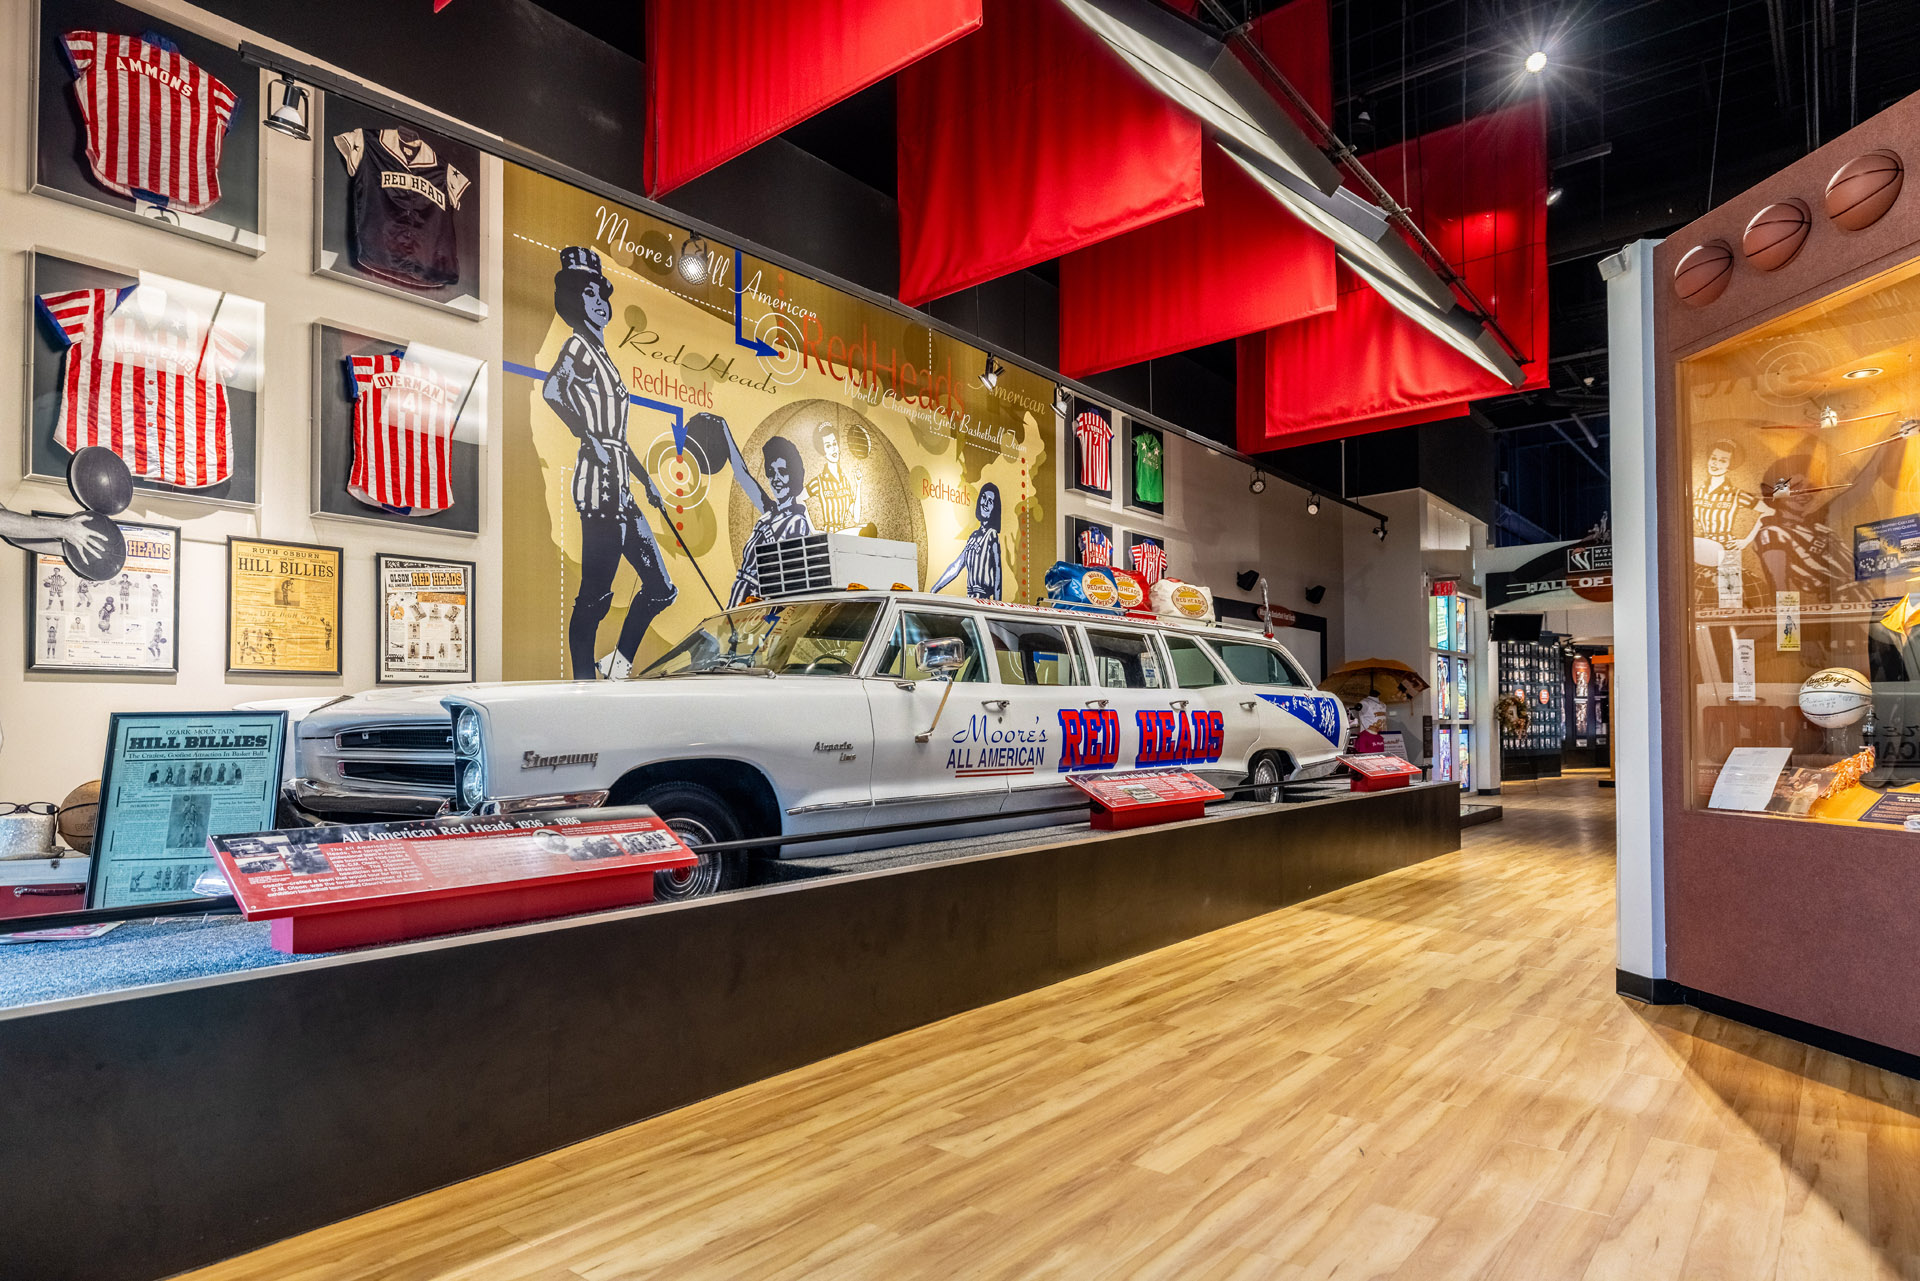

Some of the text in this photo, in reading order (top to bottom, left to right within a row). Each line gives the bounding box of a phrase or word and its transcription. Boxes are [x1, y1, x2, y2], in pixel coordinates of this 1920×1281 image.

[115, 56, 193, 98] AMMONS
[382, 172, 445, 206] RED HEAD
[596, 205, 673, 268] Moore's
[728, 270, 818, 323] American
[802, 313, 967, 420] RedHeads
[377, 375, 440, 399] OVERMAN
[632, 366, 714, 410] RedHeads
[401, 393, 416, 413] 4
[842, 372, 878, 405] World
[882, 388, 931, 425] Champion
[959, 414, 1005, 445] Basketball
[1005, 429, 1027, 452] Team
[1094, 433, 1098, 444] 7
[922, 479, 970, 506] RedHeads
[127, 540, 171, 559] HEADS
[252, 547, 320, 559] RUTH OSBURN
[238, 557, 334, 578] HILL BILLIES
[390, 574, 410, 582] OLSON
[411, 572, 462, 586] RED HEADS
[1526, 577, 1604, 593] HALL OF
[952, 714, 1048, 744] Moore's
[1058, 709, 1224, 772] RED HEADS
[129, 735, 268, 749] HILL BILLIES
[946, 746, 1045, 769] ALL AMERICAN
[342, 831, 363, 843] All
[368, 828, 436, 842] American
[439, 823, 470, 836] Red
[471, 822, 514, 833] Heads
[516, 819, 545, 829] 1936
[554, 817, 581, 827] 1986
